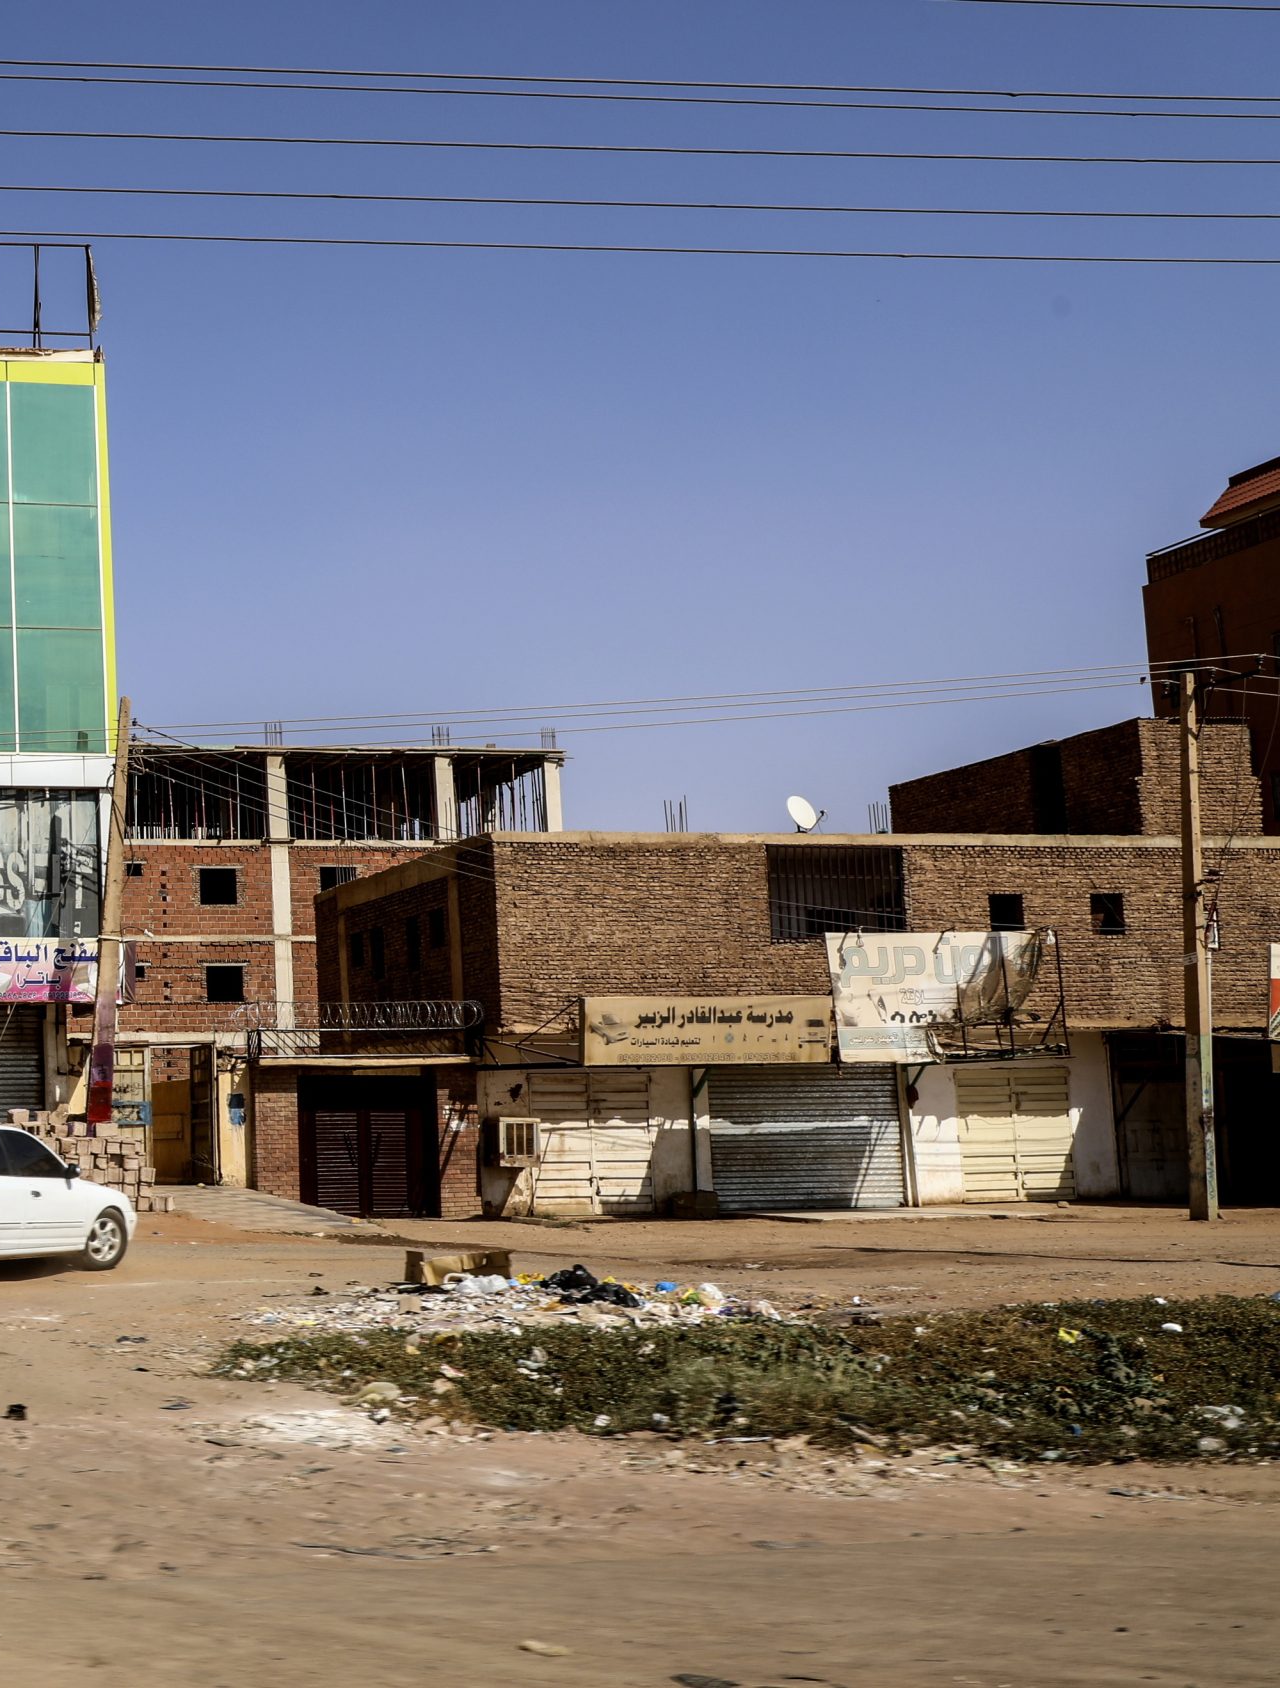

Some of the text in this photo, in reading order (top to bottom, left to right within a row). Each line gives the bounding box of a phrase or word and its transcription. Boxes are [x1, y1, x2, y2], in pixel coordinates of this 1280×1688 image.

[840, 945, 926, 988] دريم
[634, 1006, 676, 1029] الزبير
[746, 1004, 794, 1028] مدرسة
[630, 1036, 701, 1048] لتعليم قيادة السيارات
